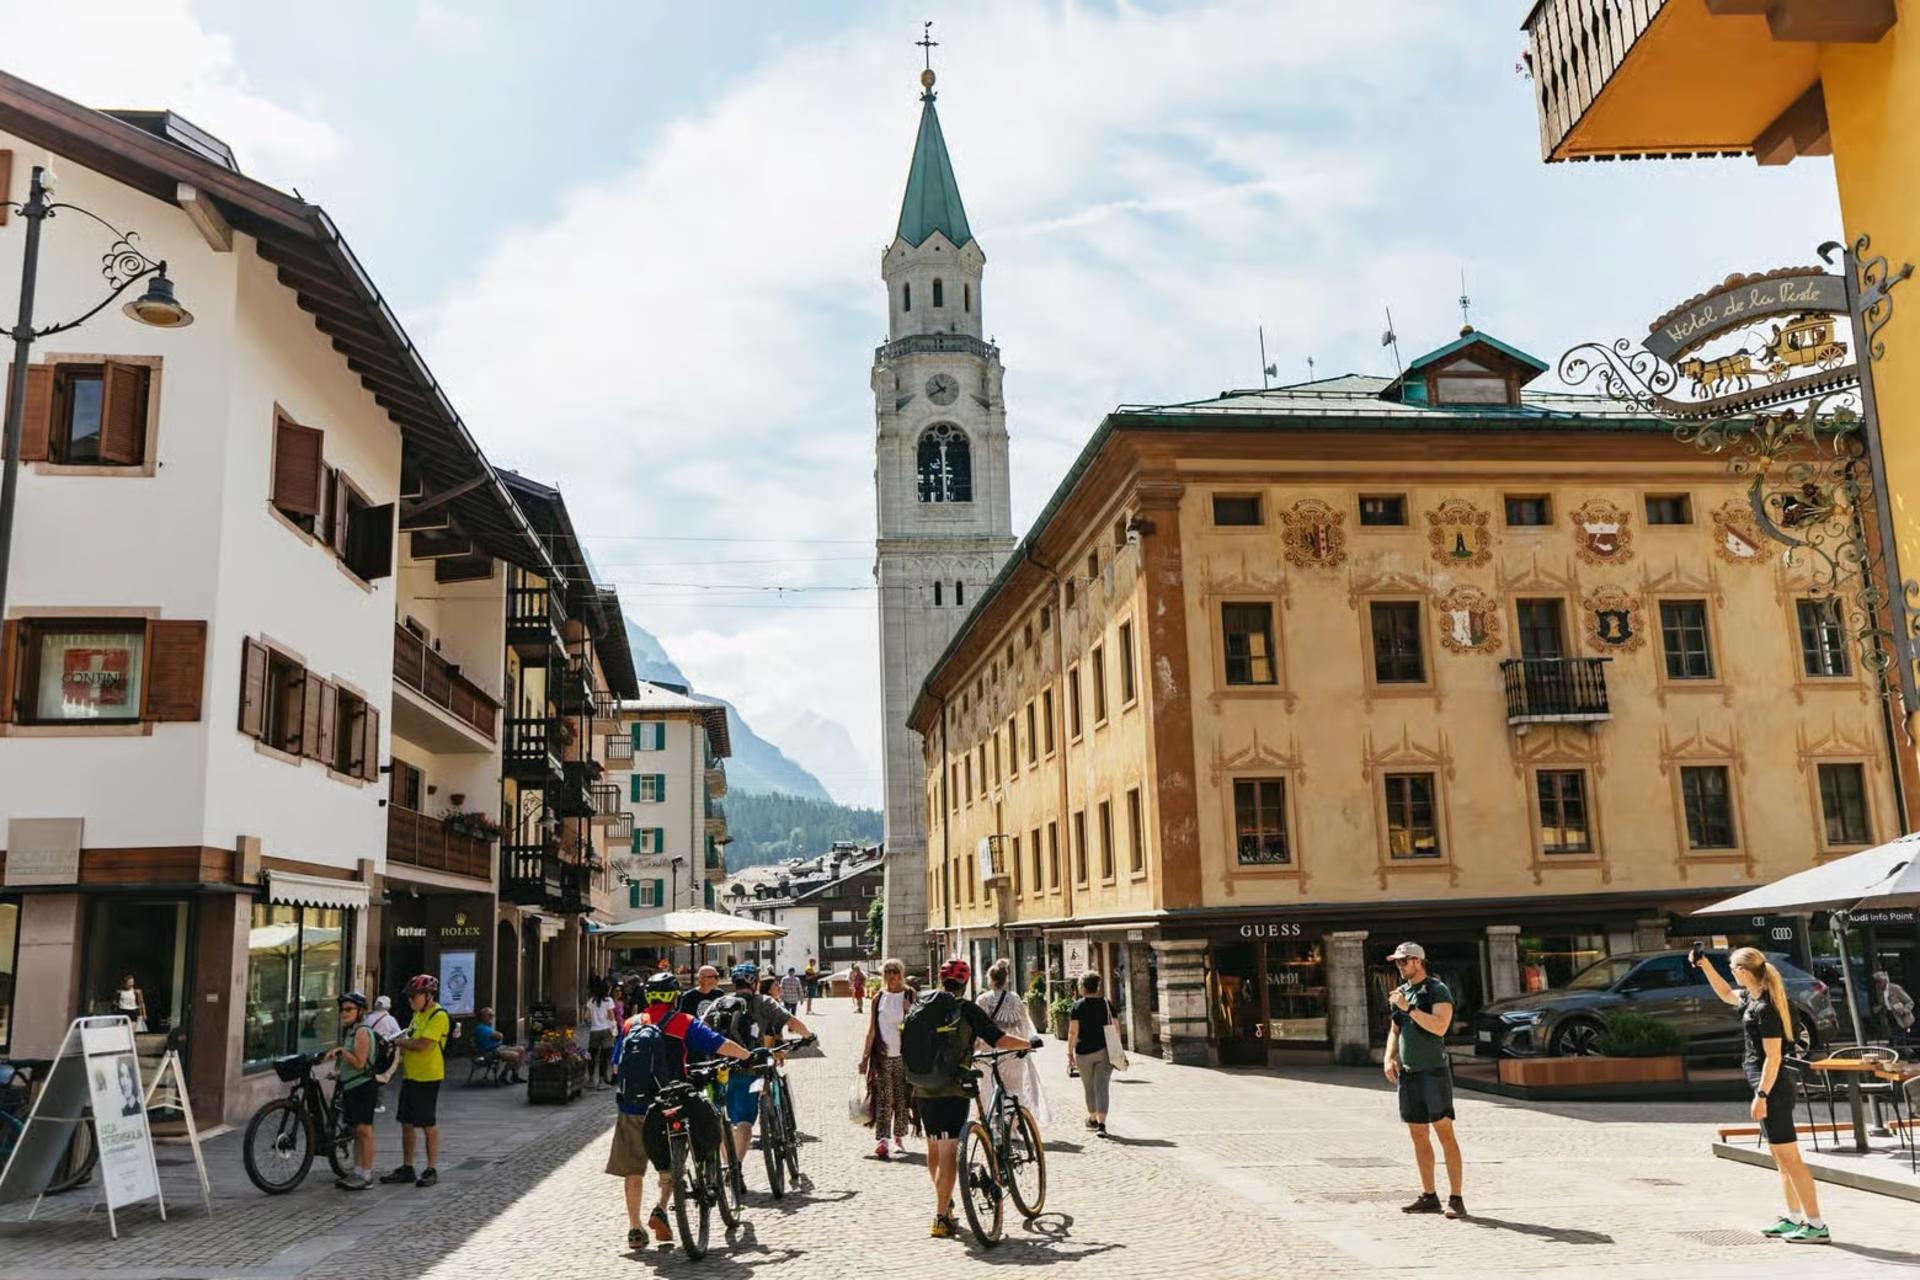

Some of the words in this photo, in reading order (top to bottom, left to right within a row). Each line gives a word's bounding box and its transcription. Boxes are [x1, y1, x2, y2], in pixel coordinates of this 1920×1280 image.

[1666, 305, 1718, 342] Hotel
[1723, 295, 1745, 317] de
[1749, 288, 1776, 309] la
[1780, 281, 1820, 302] Poste
[1870, 913, 1888, 921] Info
[1890, 912, 1913, 921] Point
[441, 927, 480, 936] ROLEX
[1240, 924, 1301, 937] GUESS
